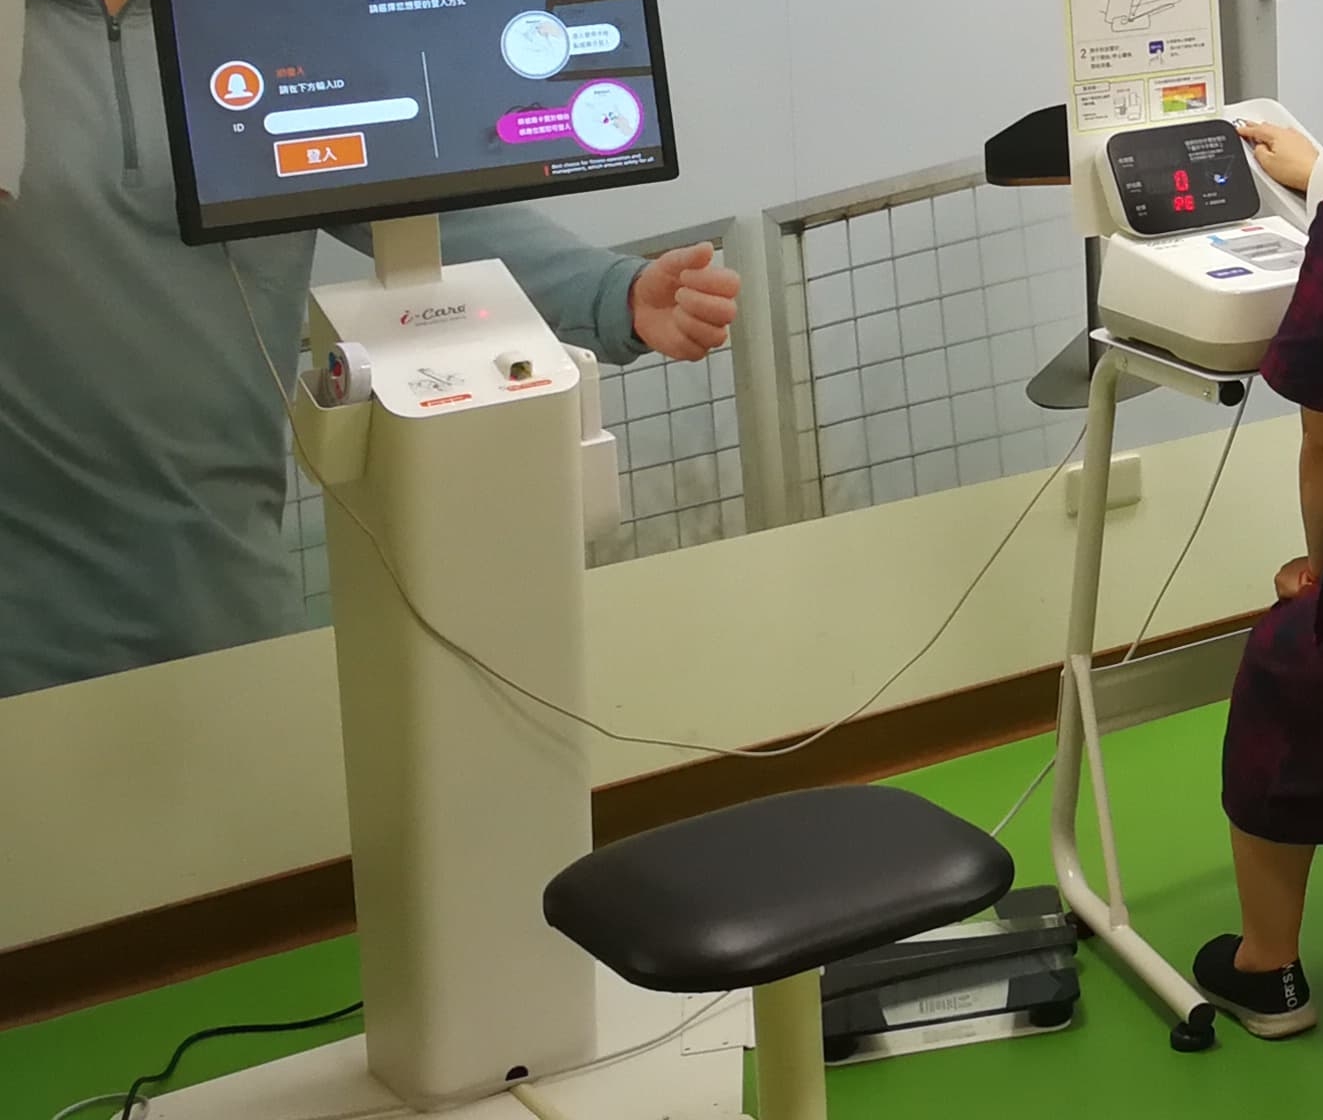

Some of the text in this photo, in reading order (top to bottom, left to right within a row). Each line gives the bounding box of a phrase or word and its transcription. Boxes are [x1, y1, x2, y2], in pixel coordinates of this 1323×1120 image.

[233, 123, 245, 133] ID
[306, 147, 337, 164] 登入
[400, 304, 467, 325] i-Care
